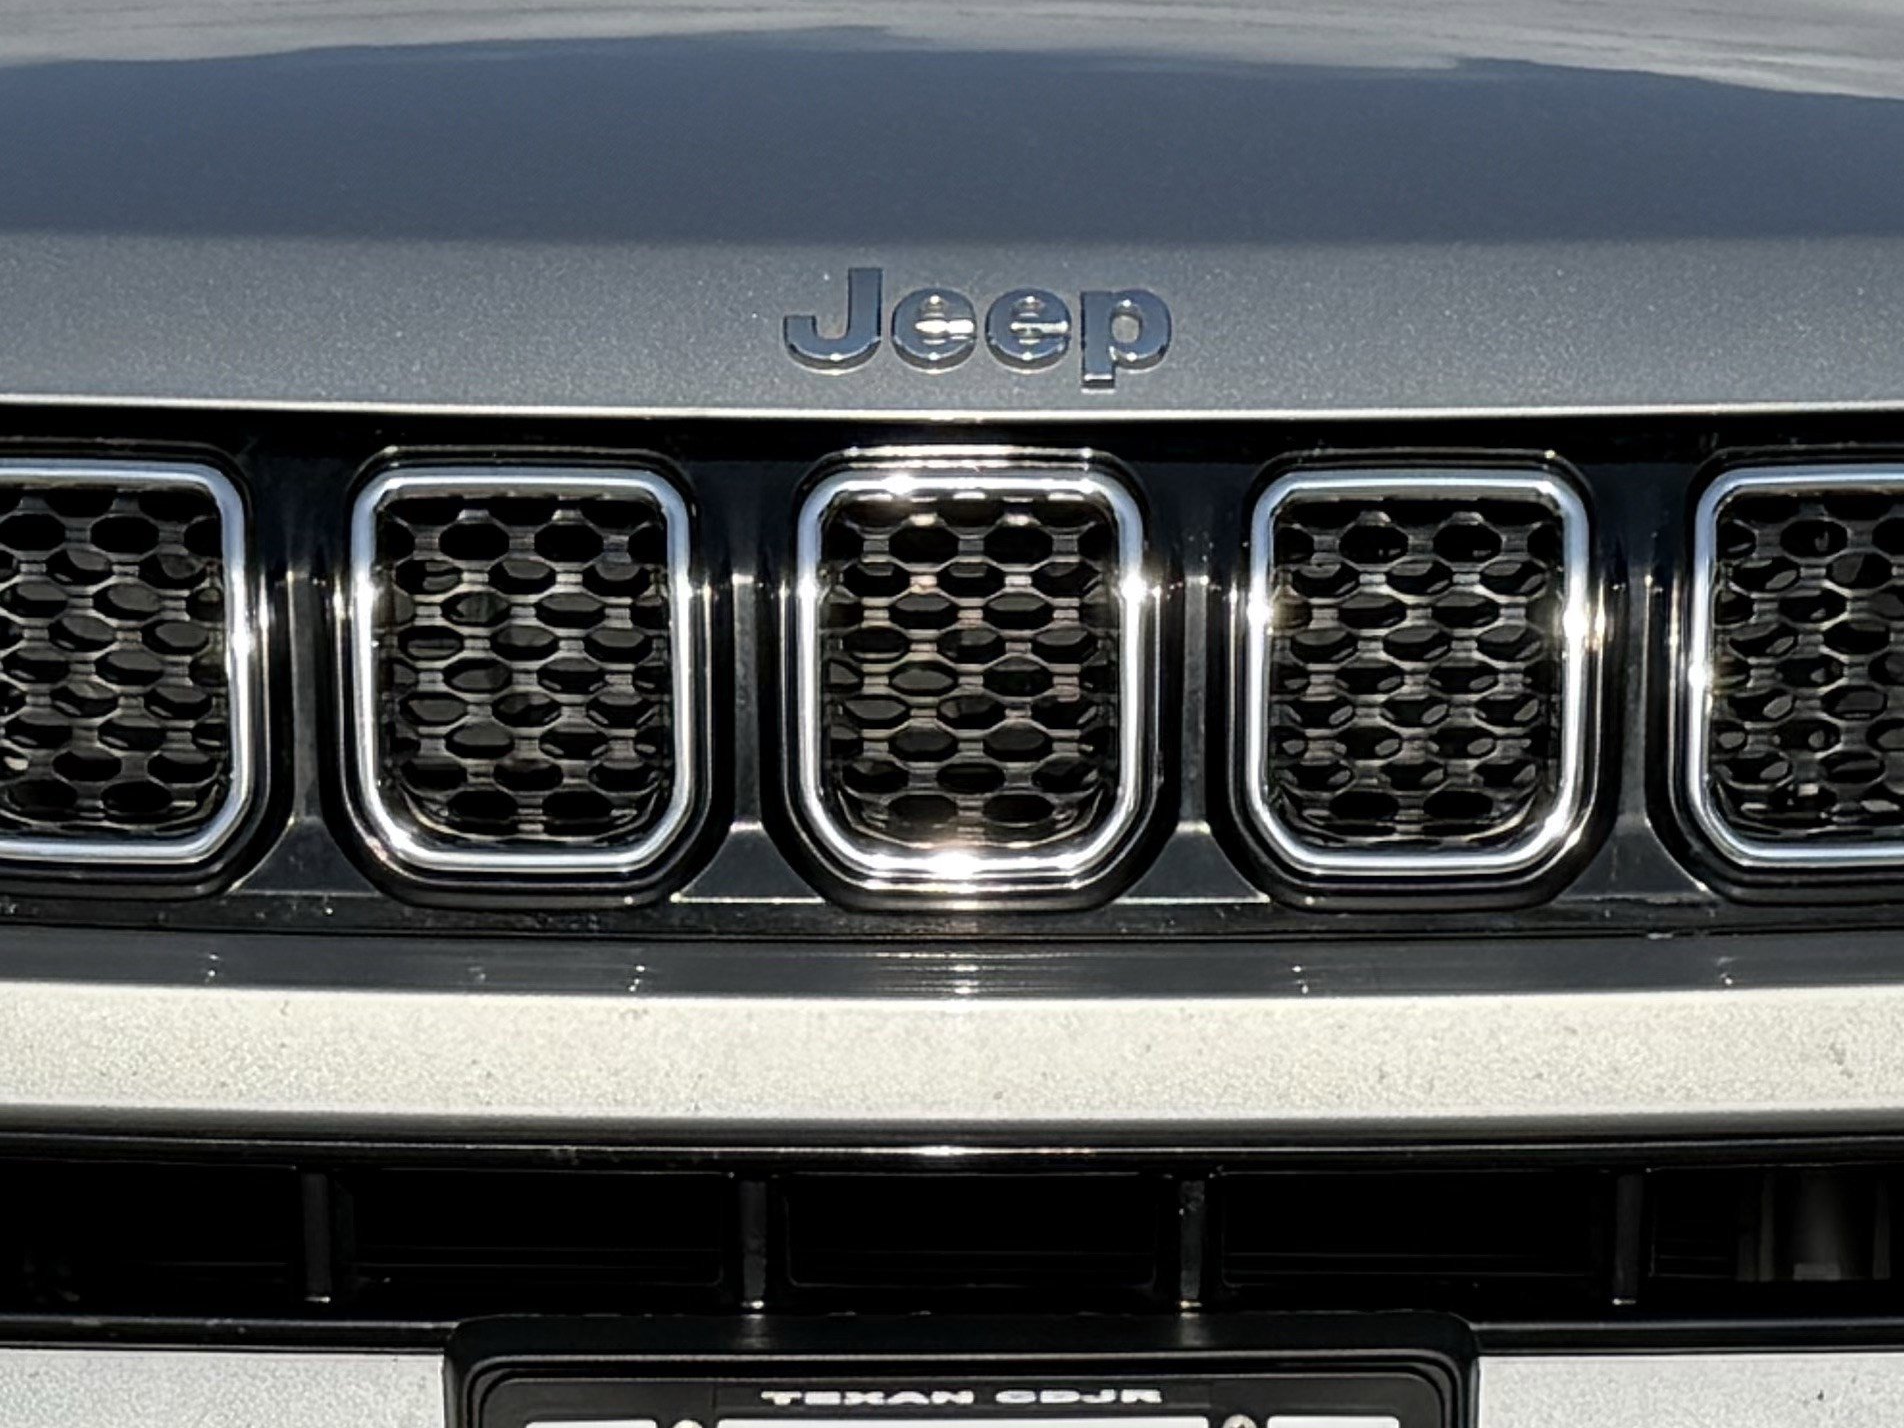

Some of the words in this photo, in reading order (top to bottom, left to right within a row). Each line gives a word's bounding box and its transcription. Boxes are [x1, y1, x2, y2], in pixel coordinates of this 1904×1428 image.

[783, 267, 1173, 392] Jeep
[760, 1390, 975, 1406] TEXAN
[995, 1389, 1163, 1404] CDJR
